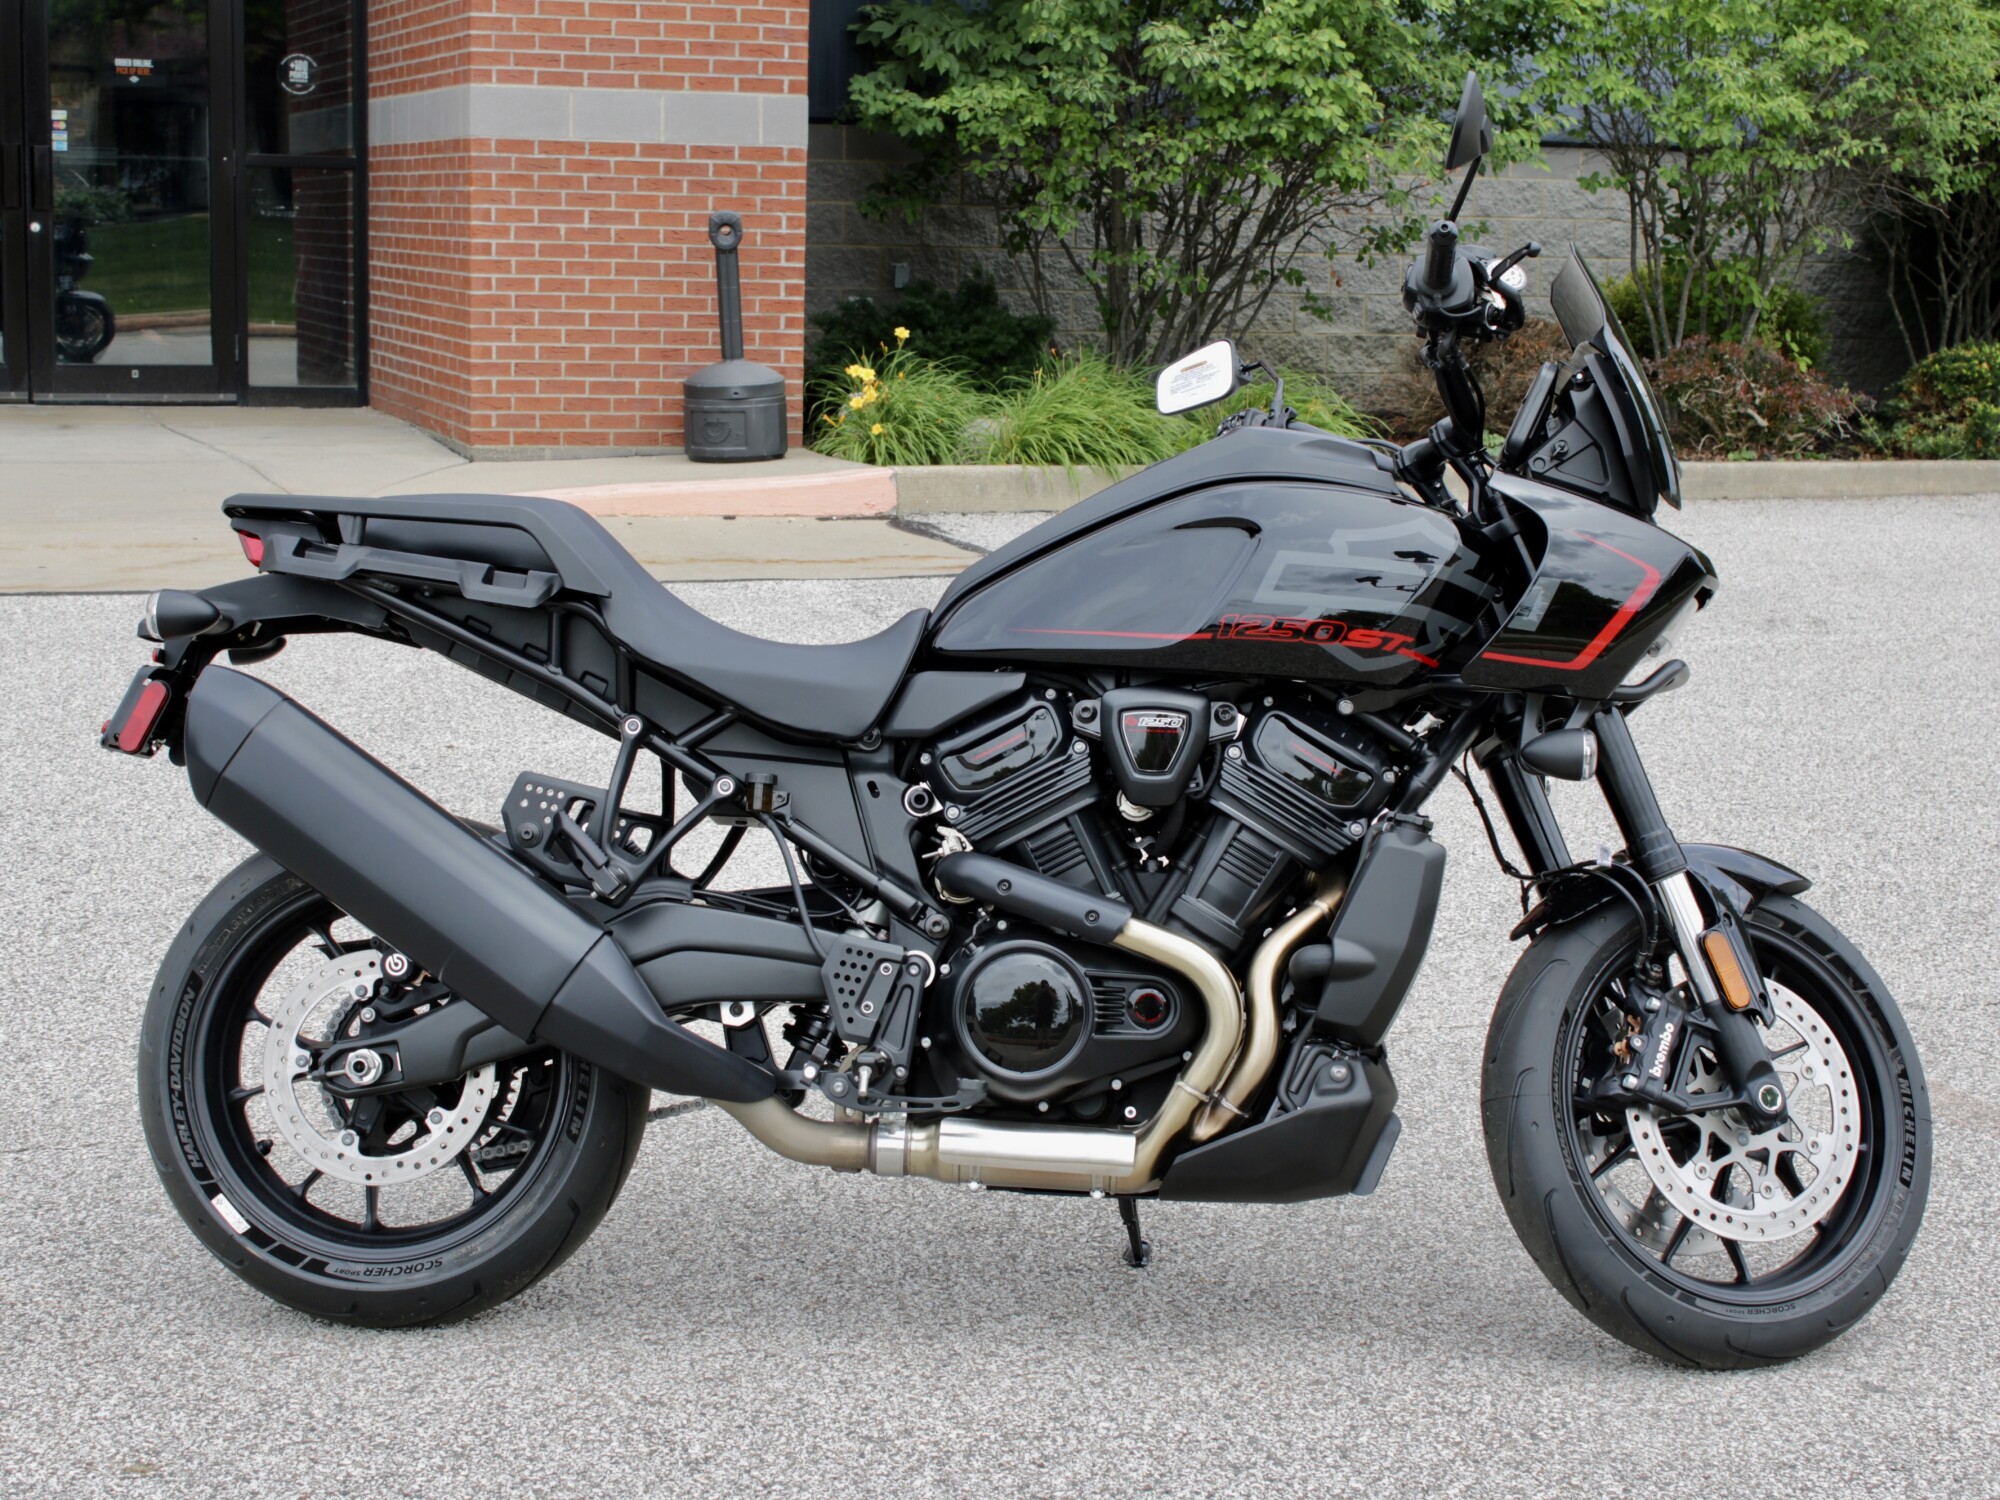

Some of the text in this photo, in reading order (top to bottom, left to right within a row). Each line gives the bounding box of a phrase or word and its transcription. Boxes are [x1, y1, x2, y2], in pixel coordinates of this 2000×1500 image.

[1138, 717, 1183, 728] 1250
[1649, 1022, 1675, 1078] brembo
[169, 985, 204, 1169] HARLEY-DAVIDSON
[1897, 1077, 1914, 1183] MICHELIN
[333, 1256, 444, 1277] SCORCHER SPORT
[1747, 1302, 1797, 1315] SCORCHER
